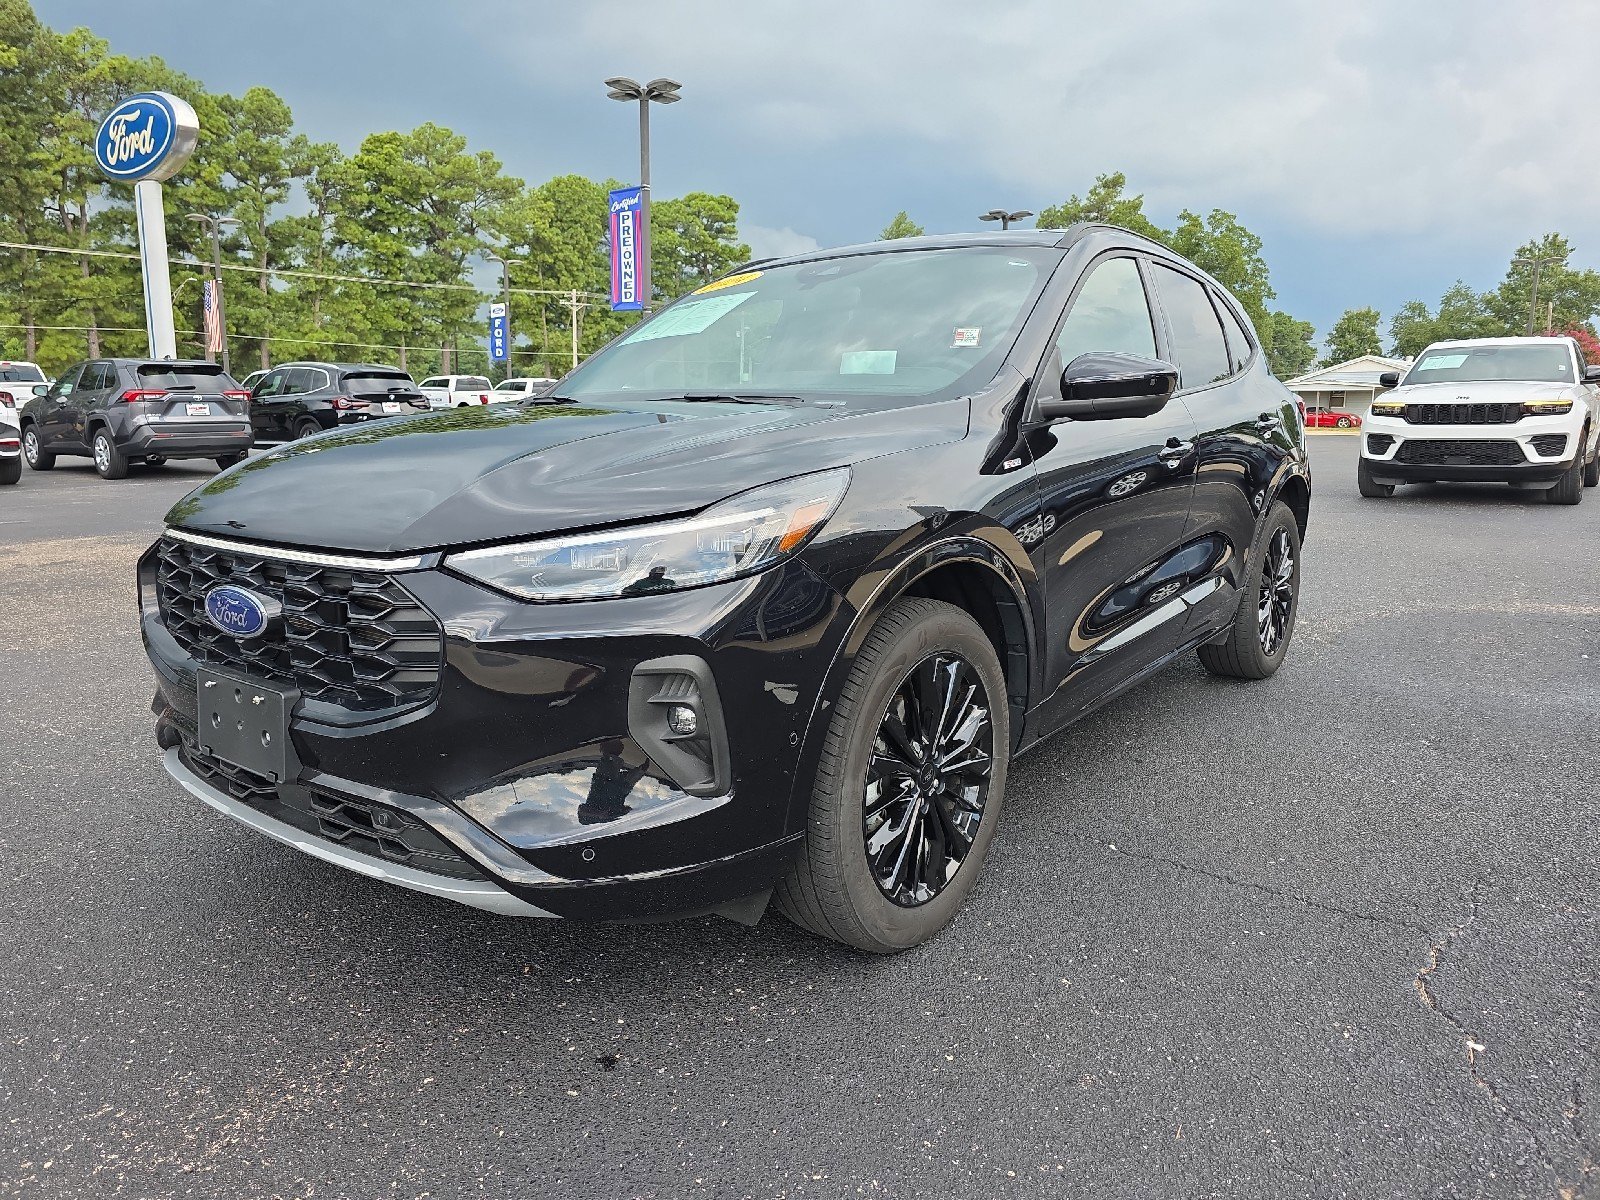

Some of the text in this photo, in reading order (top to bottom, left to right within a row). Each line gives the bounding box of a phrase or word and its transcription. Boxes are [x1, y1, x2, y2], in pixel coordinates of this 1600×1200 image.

[106, 109, 155, 165] Ford
[611, 193, 640, 211] Certified
[494, 318, 503, 357] FORD
[214, 595, 250, 628] Ford
